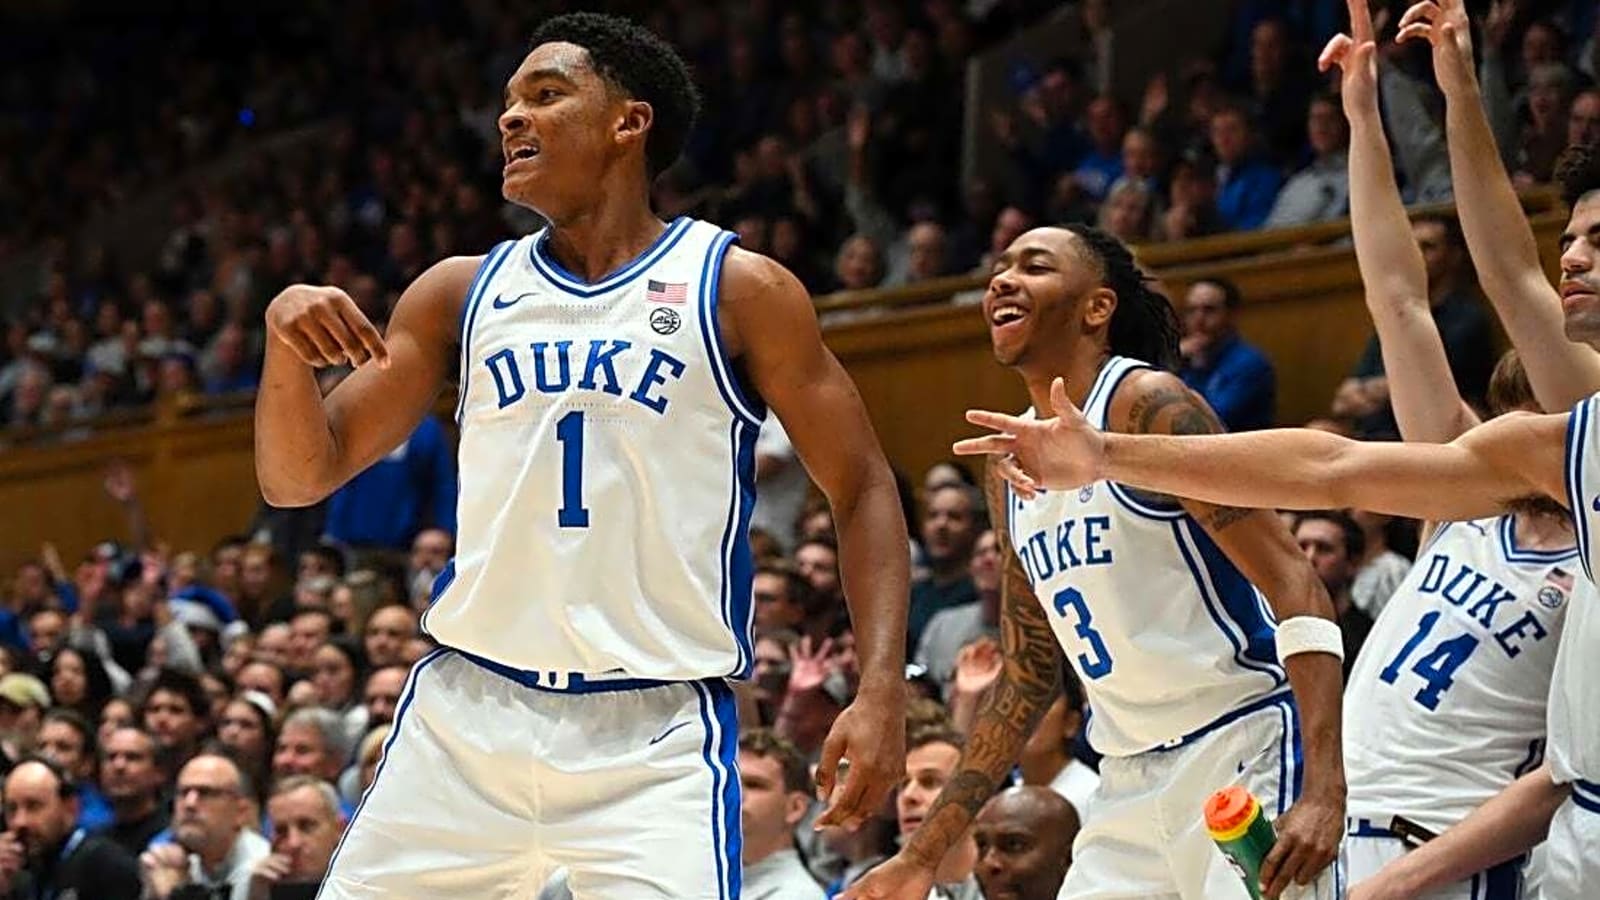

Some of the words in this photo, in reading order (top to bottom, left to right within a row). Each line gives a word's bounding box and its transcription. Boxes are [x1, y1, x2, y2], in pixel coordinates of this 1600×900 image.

[485, 340, 686, 415] DUKE
[556, 411, 589, 528] 1
[1053, 587, 1113, 680] 3
[1418, 554, 1548, 659] DUKE
[1379, 611, 1480, 712] 14
